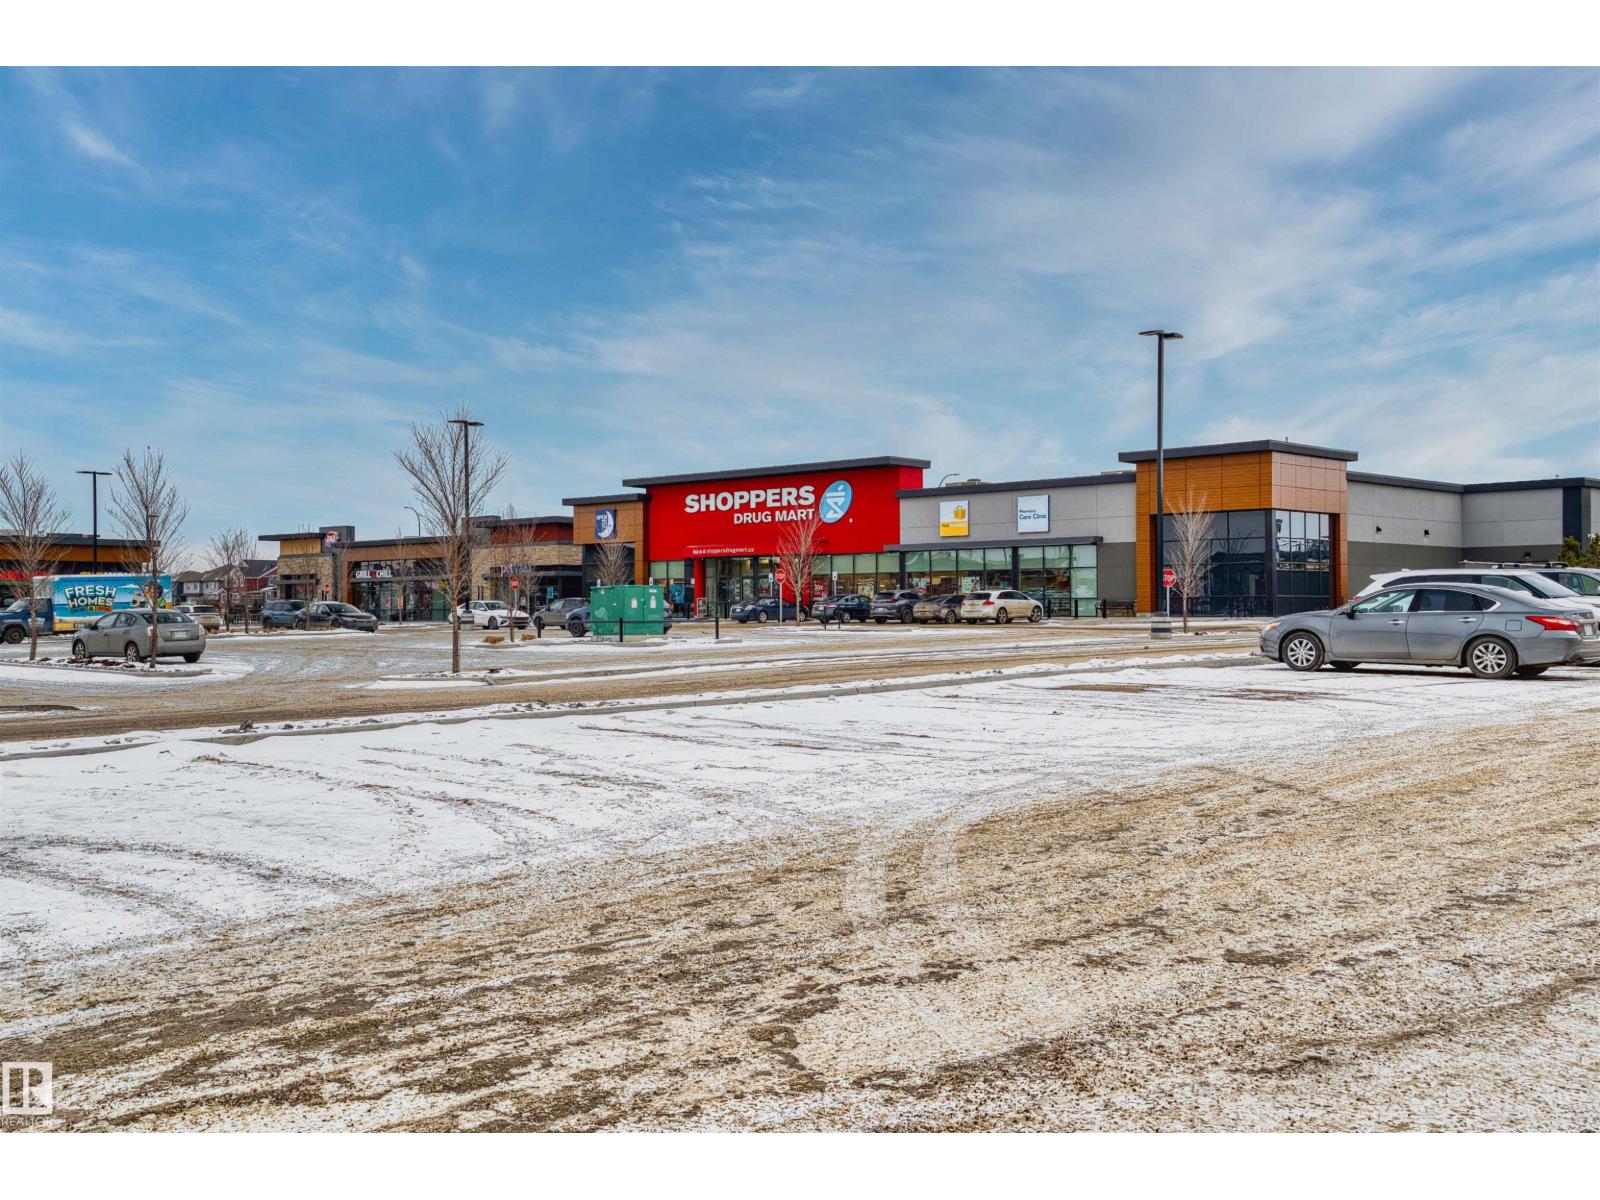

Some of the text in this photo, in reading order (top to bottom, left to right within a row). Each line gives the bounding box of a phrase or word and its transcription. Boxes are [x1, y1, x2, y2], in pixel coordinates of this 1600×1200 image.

[684, 485, 815, 513] SHOPPERS
[733, 508, 815, 525] DRUG MART
[64, 585, 117, 598] FRESH
[68, 596, 114, 608] HOMES
